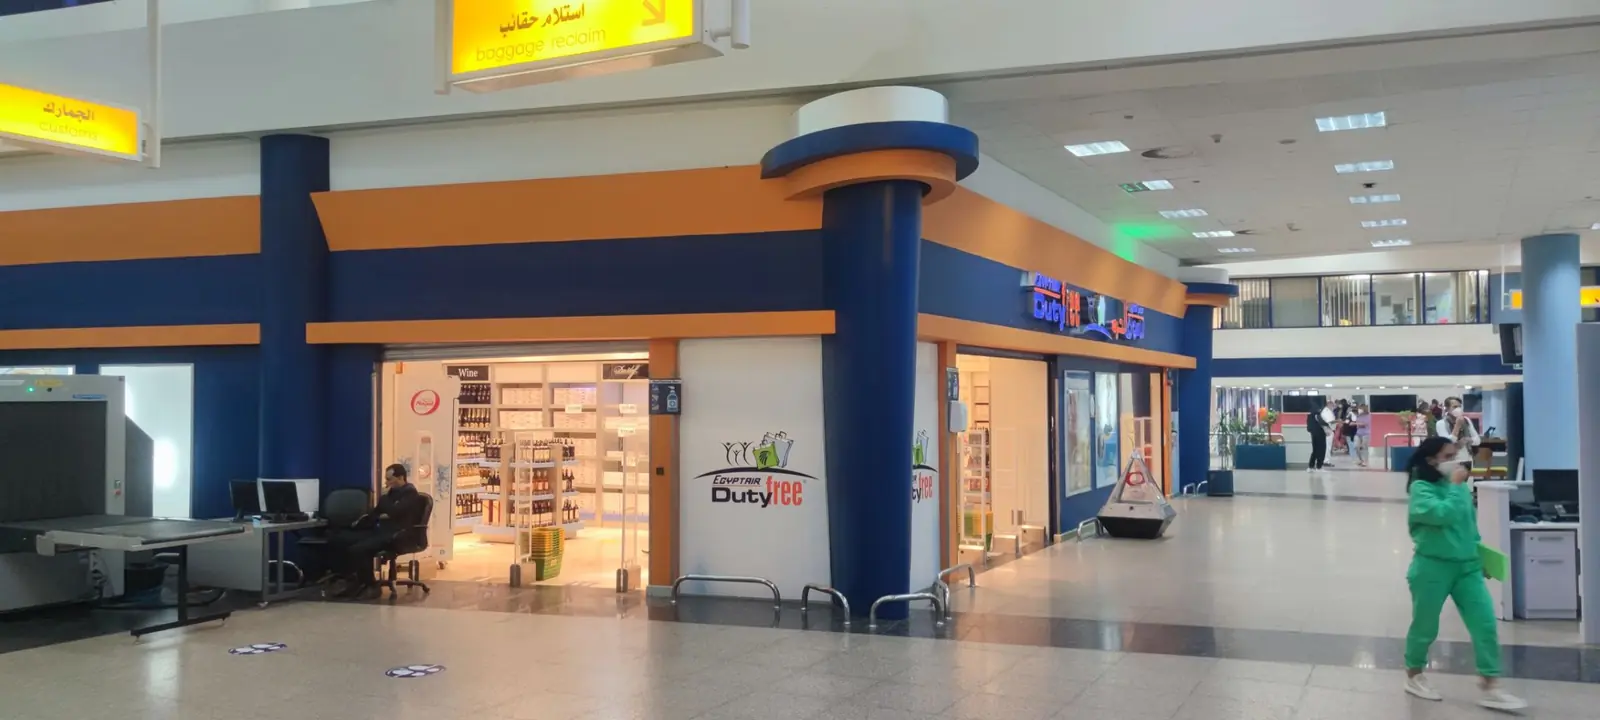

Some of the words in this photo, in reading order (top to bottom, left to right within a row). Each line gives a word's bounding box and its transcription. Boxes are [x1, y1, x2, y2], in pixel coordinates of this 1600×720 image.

[499, 10, 539, 37] حقائب
[541, 2, 585, 29] استلام
[476, 38, 545, 62] baggage
[551, 27, 606, 52] reclaim
[43, 102, 95, 122] الجمارك
[39, 121, 98, 141] customs
[1034, 291, 1066, 332] Duty
[458, 368, 479, 378] Wine
[711, 487, 773, 508] Duty
[766, 475, 803, 506] free
[712, 474, 762, 486] EGYPTAIR
